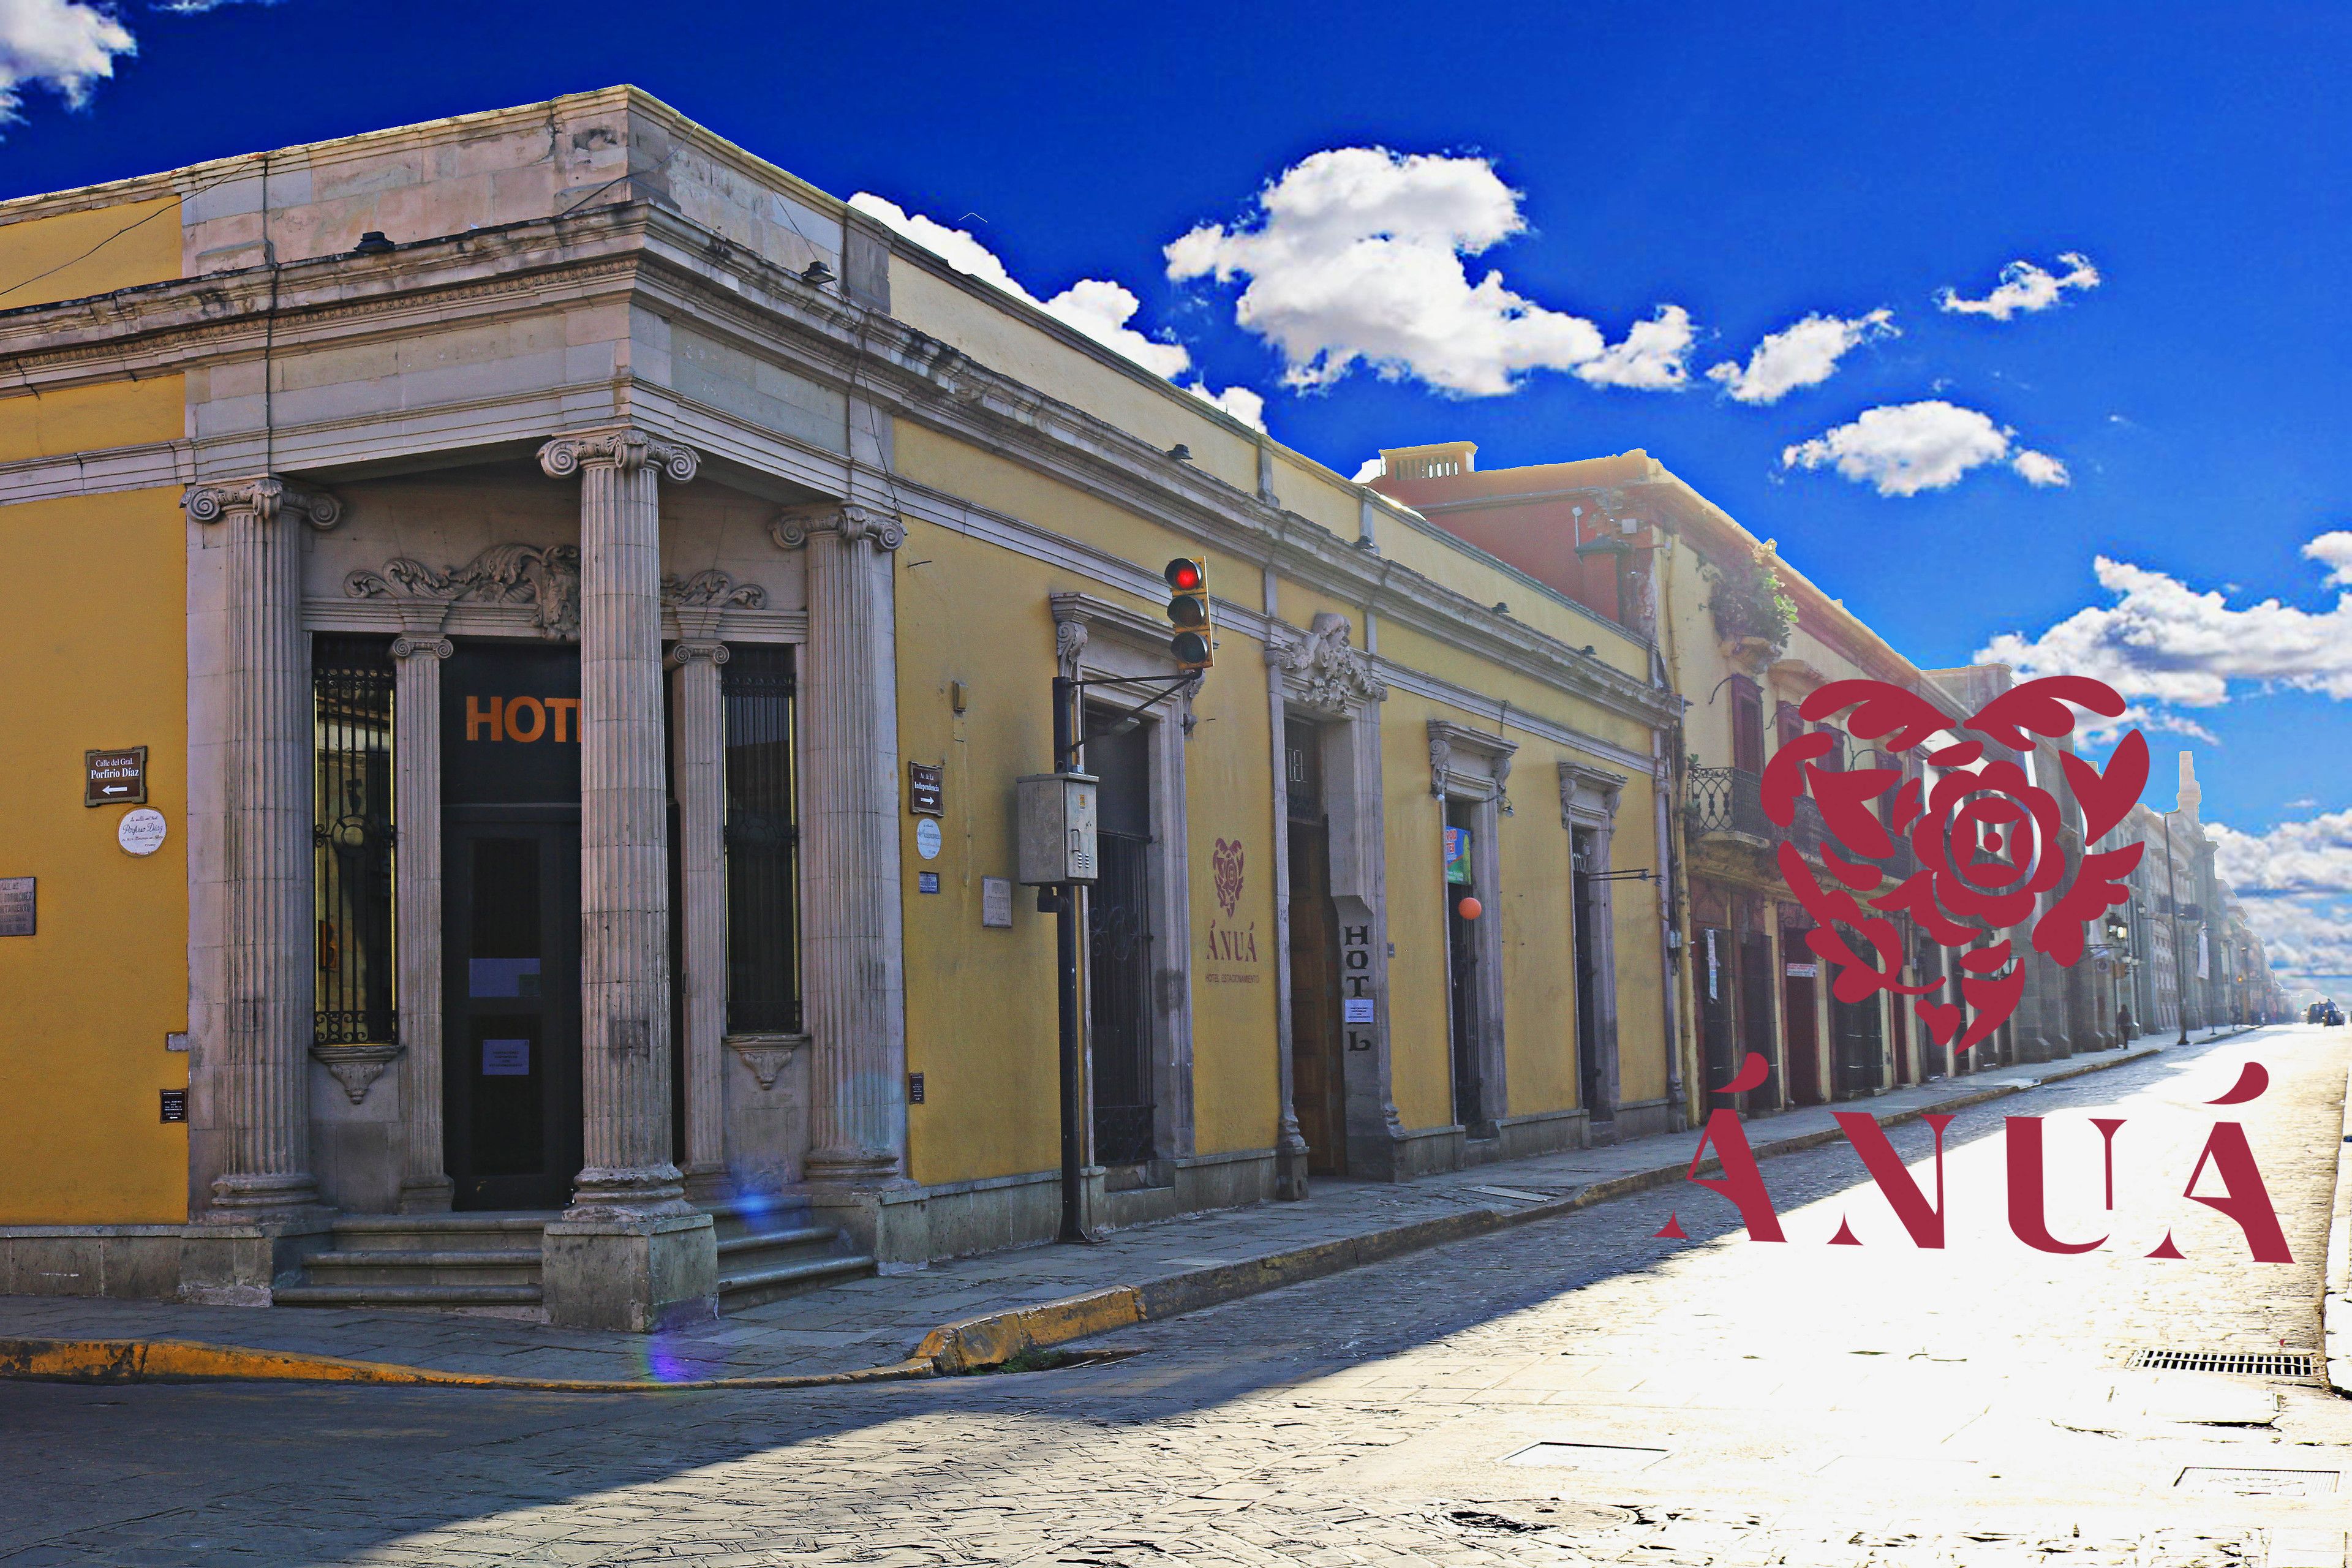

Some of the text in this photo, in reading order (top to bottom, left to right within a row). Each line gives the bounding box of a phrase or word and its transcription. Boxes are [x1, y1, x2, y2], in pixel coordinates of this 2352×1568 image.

[466, 696, 581, 743] HOT
[91, 767, 139, 779] Porfirio Díaz
[914, 781, 940, 792] Independencia
[1344, 925, 1371, 1052] HOTL
